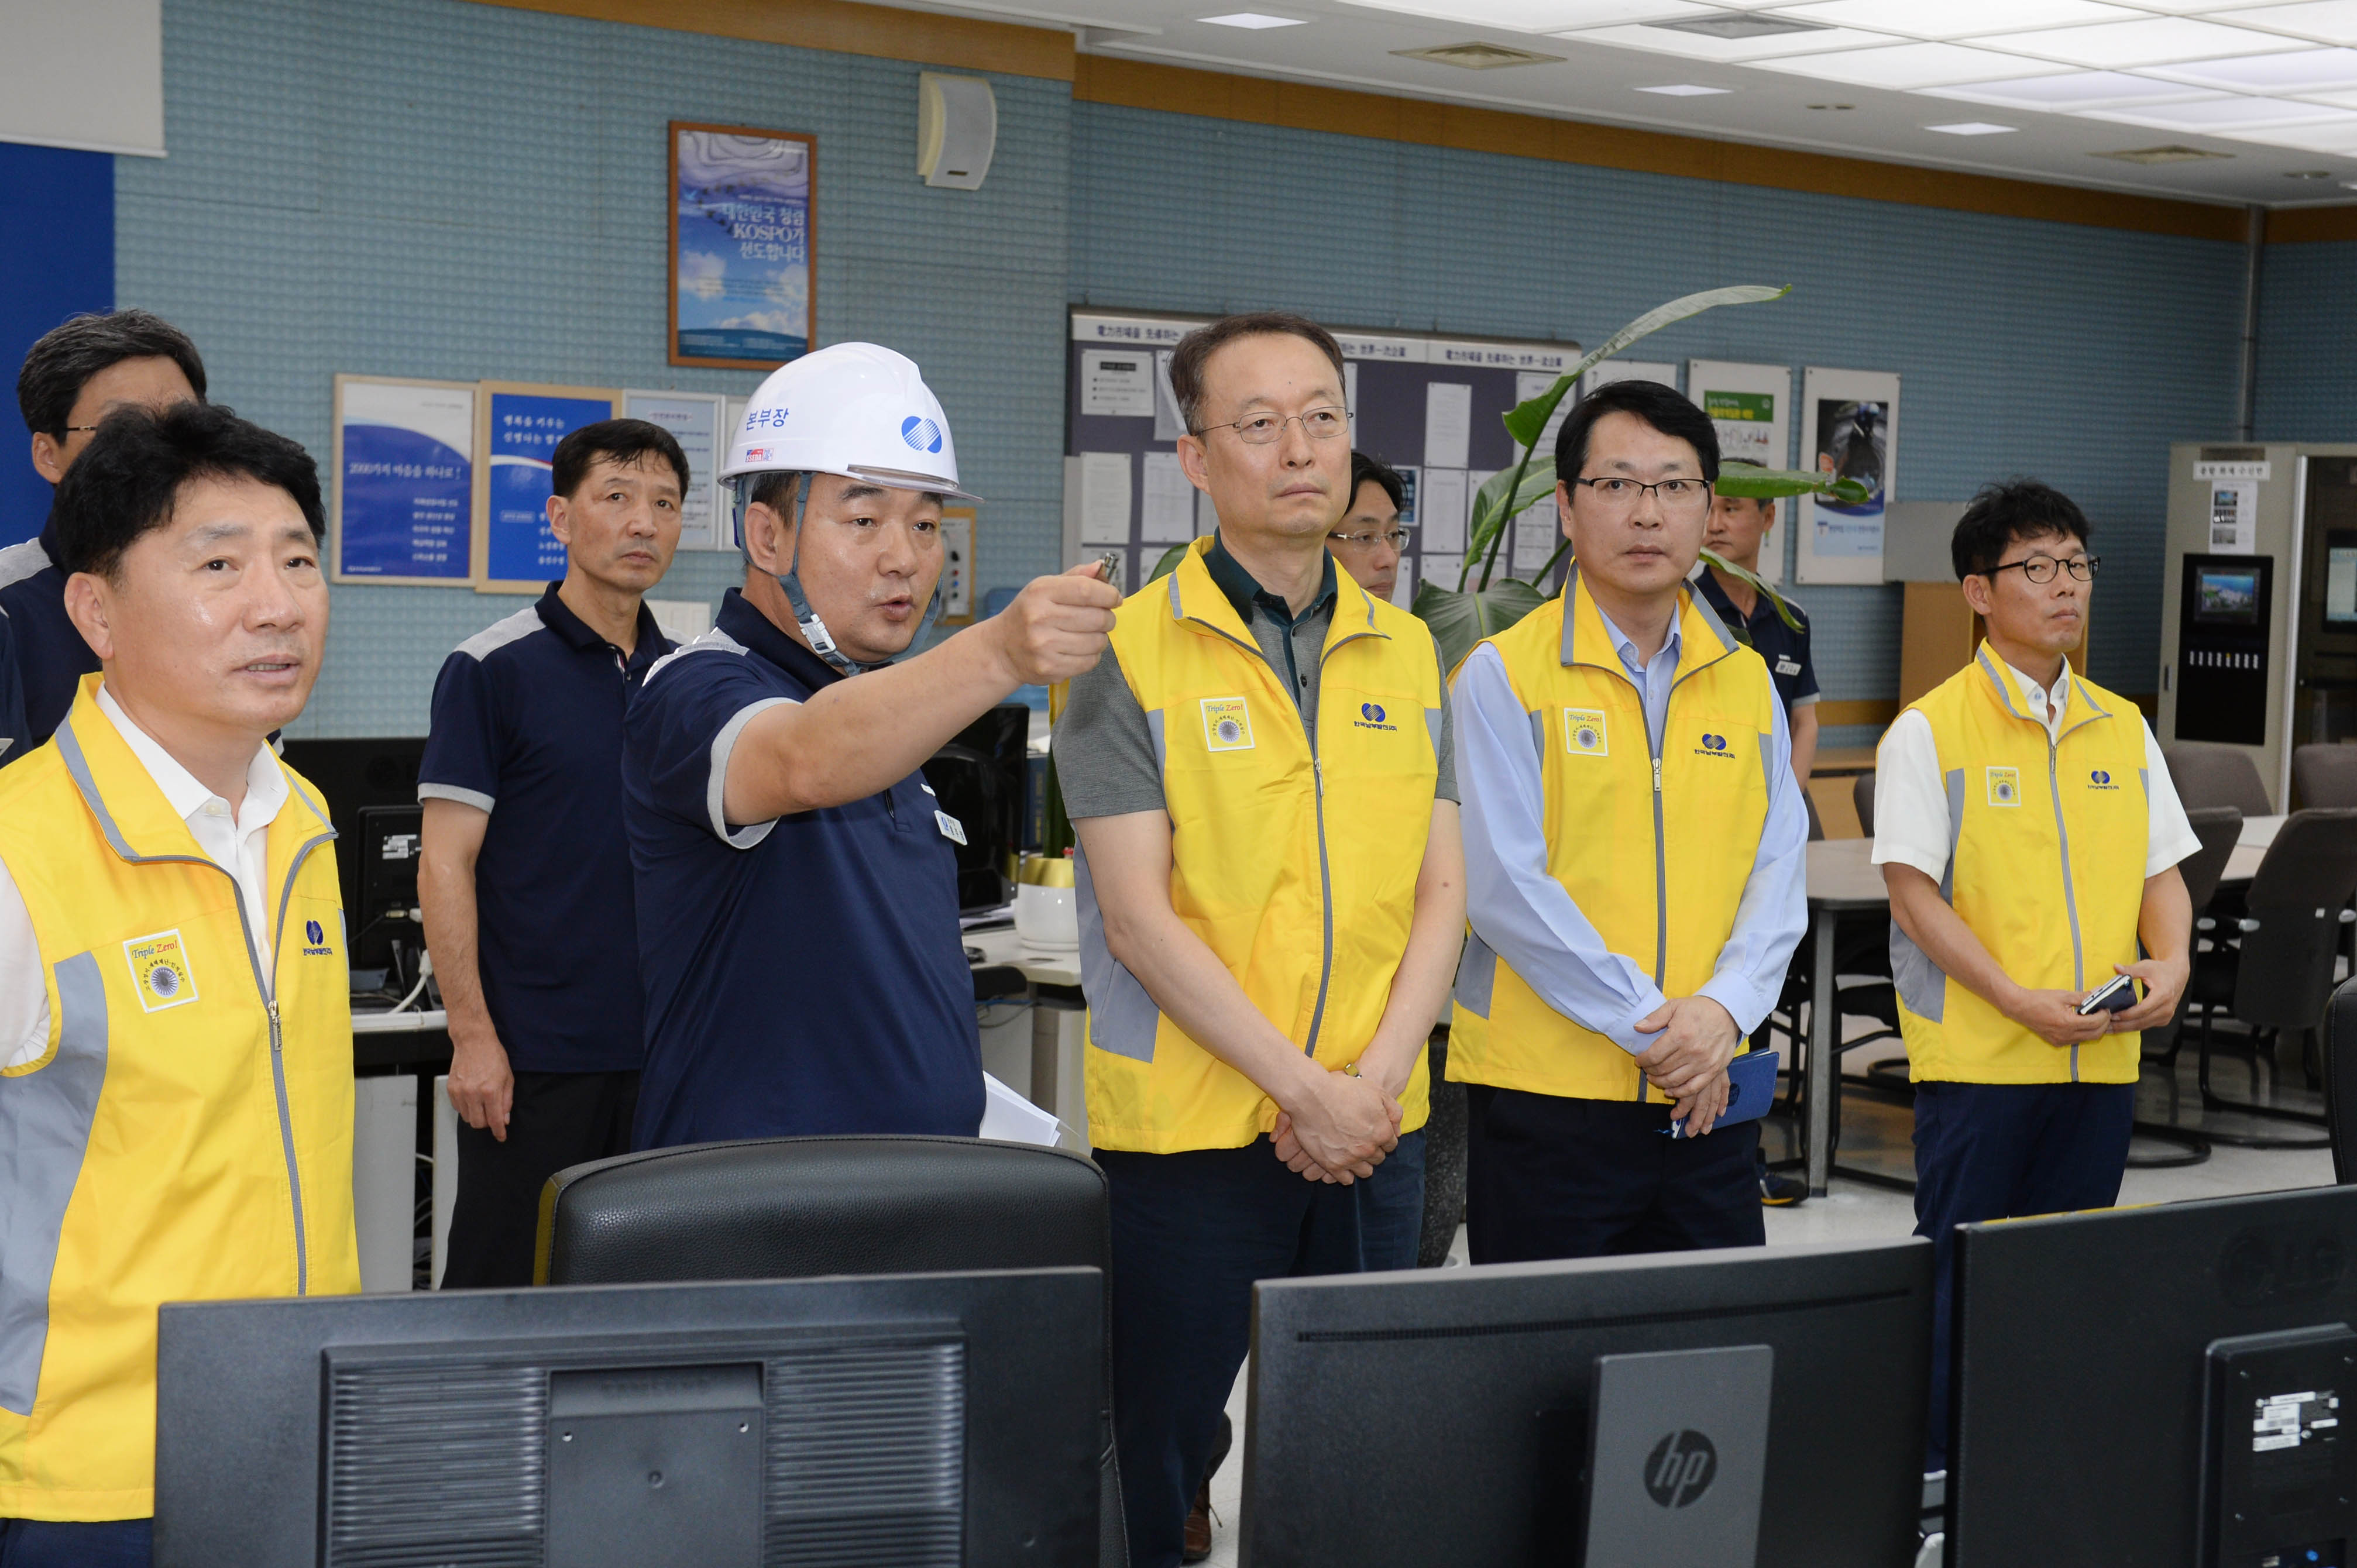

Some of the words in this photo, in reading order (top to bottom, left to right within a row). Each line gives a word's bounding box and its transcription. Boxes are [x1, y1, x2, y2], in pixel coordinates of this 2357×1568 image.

[722, 205, 776, 223] 대한민국
[781, 207, 805, 226] 청렴
[734, 222, 805, 244] KOSPO가
[740, 241, 805, 263] 선도합니다
[746, 408, 789, 431] 본부장
[1207, 704, 1225, 714] Triple
[1569, 714, 1586, 723] Triple
[132, 945, 155, 959] Triple
[156, 940, 178, 954] Zero!
[1653, 1432, 1709, 1508] hp
